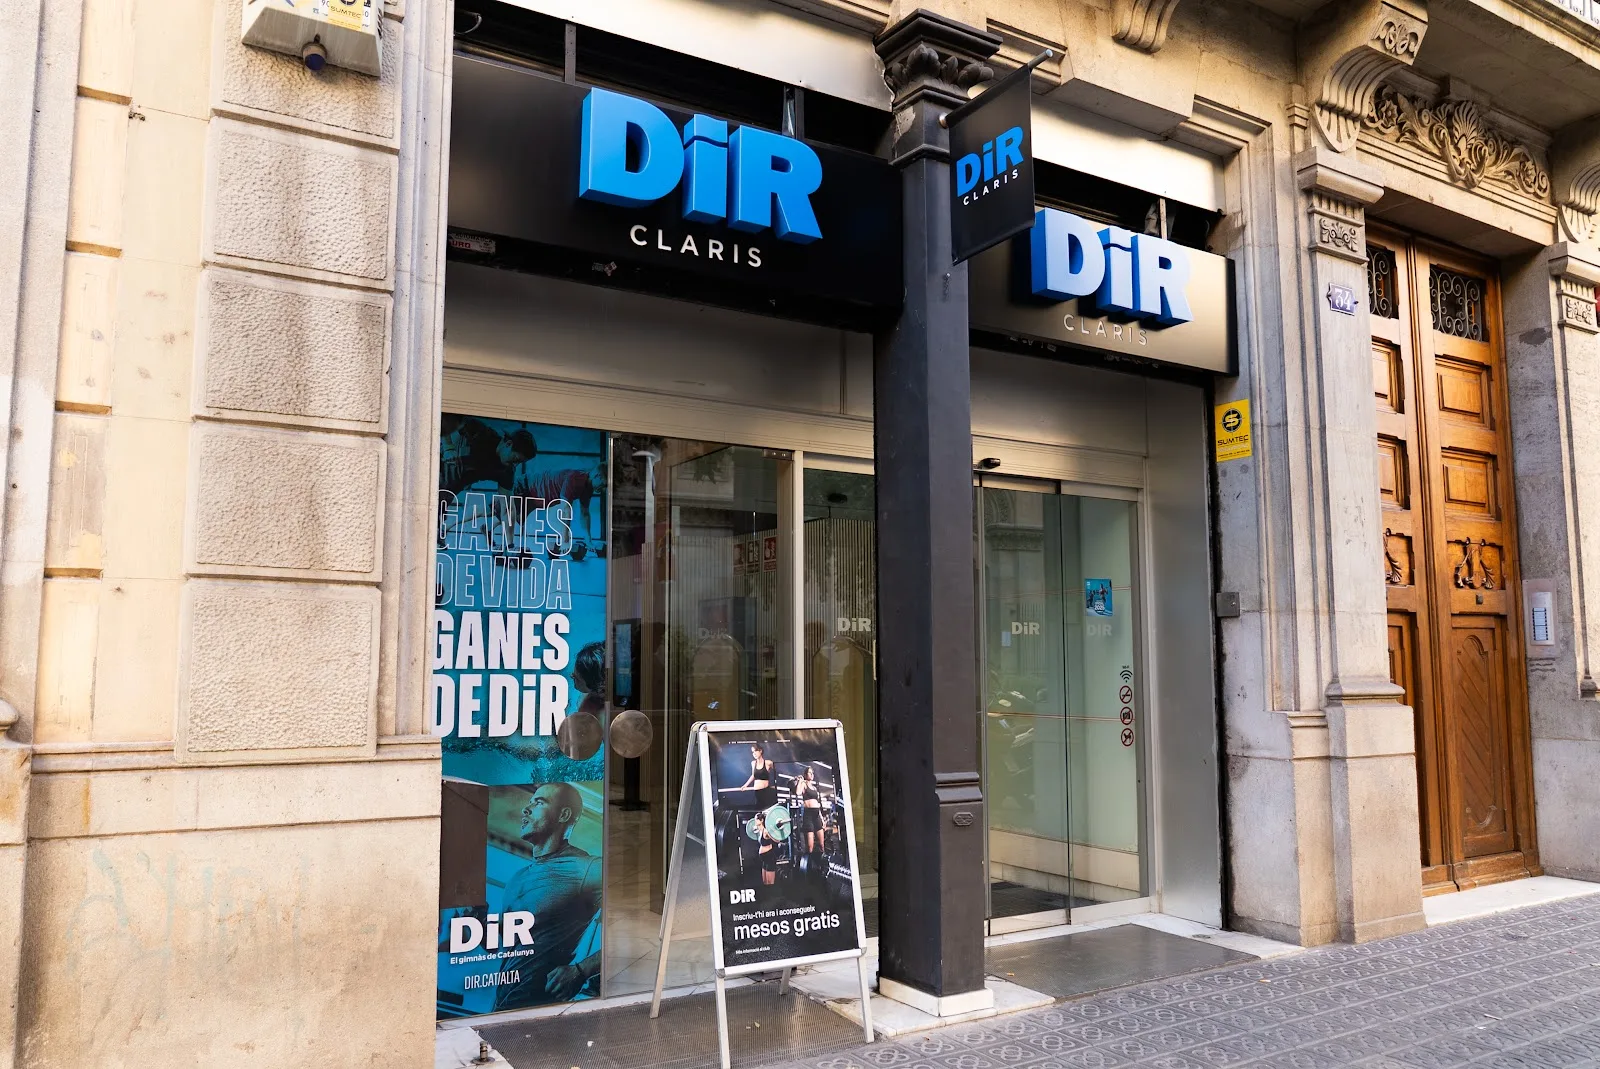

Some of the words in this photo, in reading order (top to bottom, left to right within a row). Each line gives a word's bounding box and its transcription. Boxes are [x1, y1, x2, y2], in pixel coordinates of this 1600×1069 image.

[330, 6, 361, 18] SUMTEC
[579, 86, 823, 245] DiR
[956, 126, 1024, 197] DiR
[963, 168, 1019, 206] CLARIS
[629, 224, 762, 268] CLARIS
[1030, 207, 1194, 325] DiR
[1334, 287, 1351, 311] 34
[1063, 313, 1149, 346] CLARIS
[1217, 434, 1249, 446] SUMTEC
[437, 489, 573, 557] GANES
[837, 617, 872, 632] DiR
[1011, 621, 1040, 635] DiR
[433, 609, 570, 671] GANES
[729, 888, 756, 904] DiR
[732, 910, 765, 921] Inscriu-t'hi
[779, 905, 816, 916] aconsegueix
[734, 919, 790, 940] mesos
[793, 910, 840, 937] gratis
[450, 911, 535, 953] DiR
[459, 954, 486, 964] gimnàs
[497, 948, 534, 959] Catalunya
[464, 969, 520, 990] DIR.CAT/ALTA
